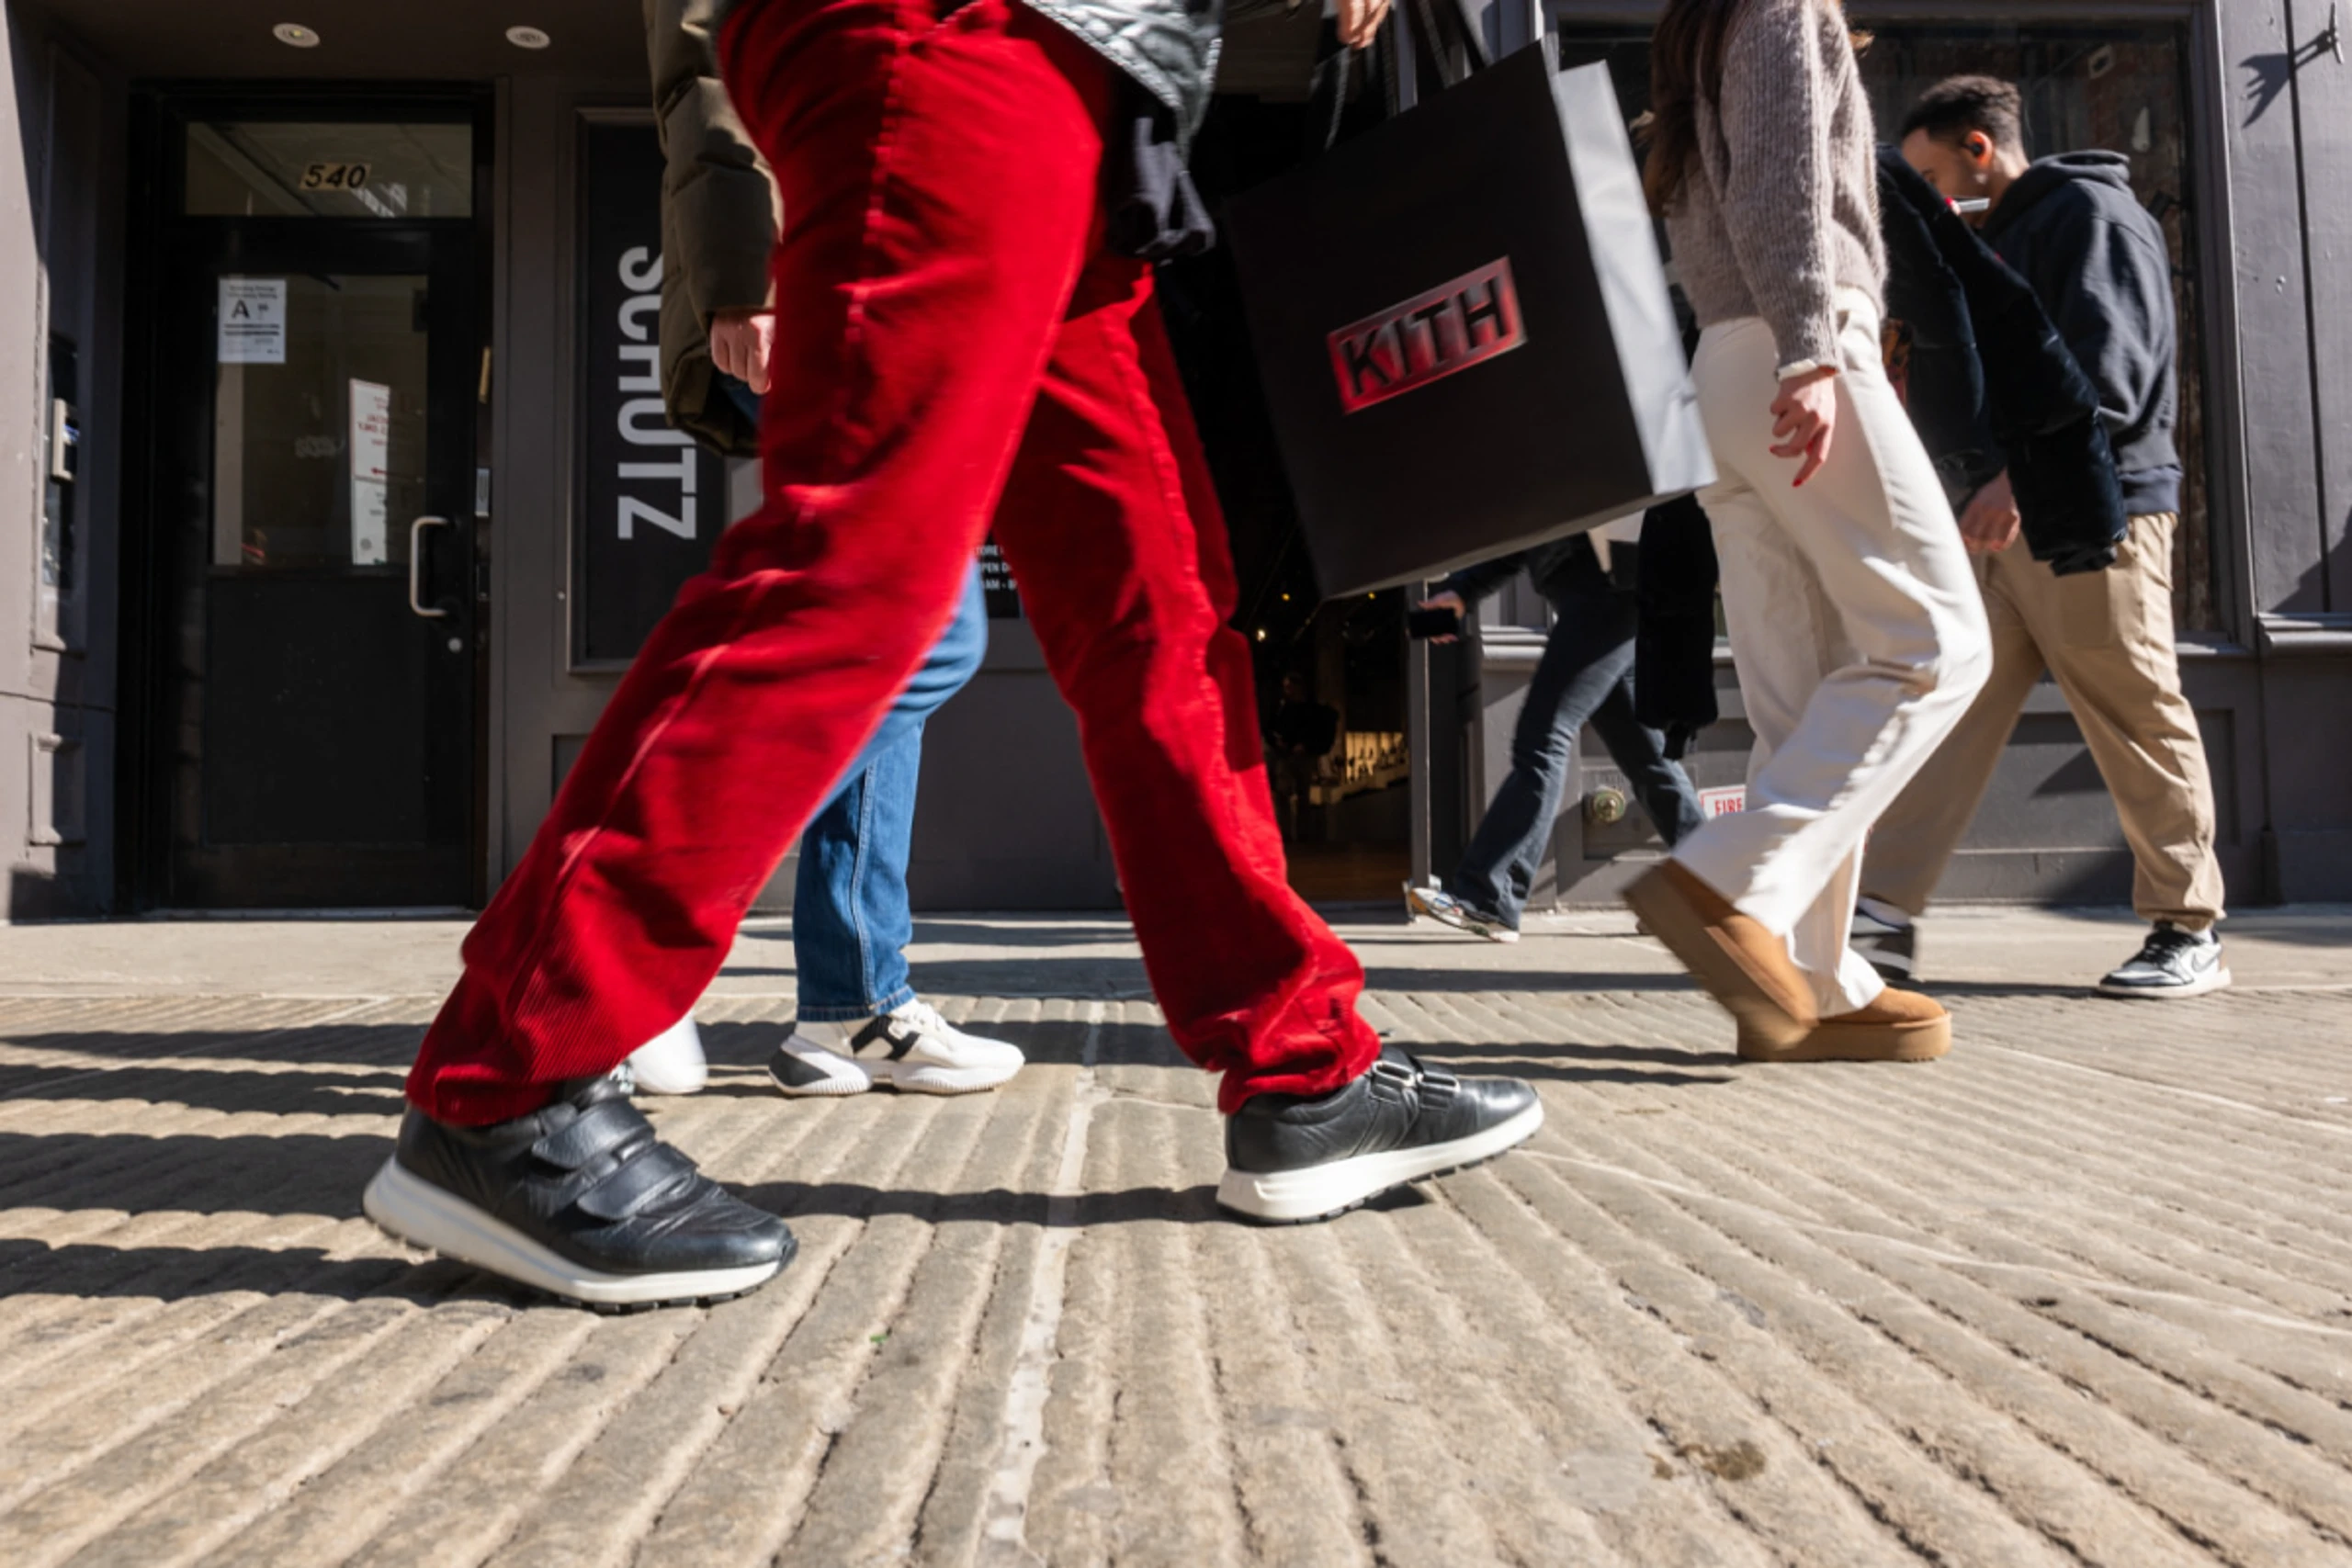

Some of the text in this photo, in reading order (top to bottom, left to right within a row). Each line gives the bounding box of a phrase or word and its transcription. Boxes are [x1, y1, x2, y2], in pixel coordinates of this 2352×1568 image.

[304, 164, 367, 188] 540
[232, 299, 250, 319] A
[1340, 276, 1509, 396] KITH
[1714, 797, 1742, 817] FIRE
